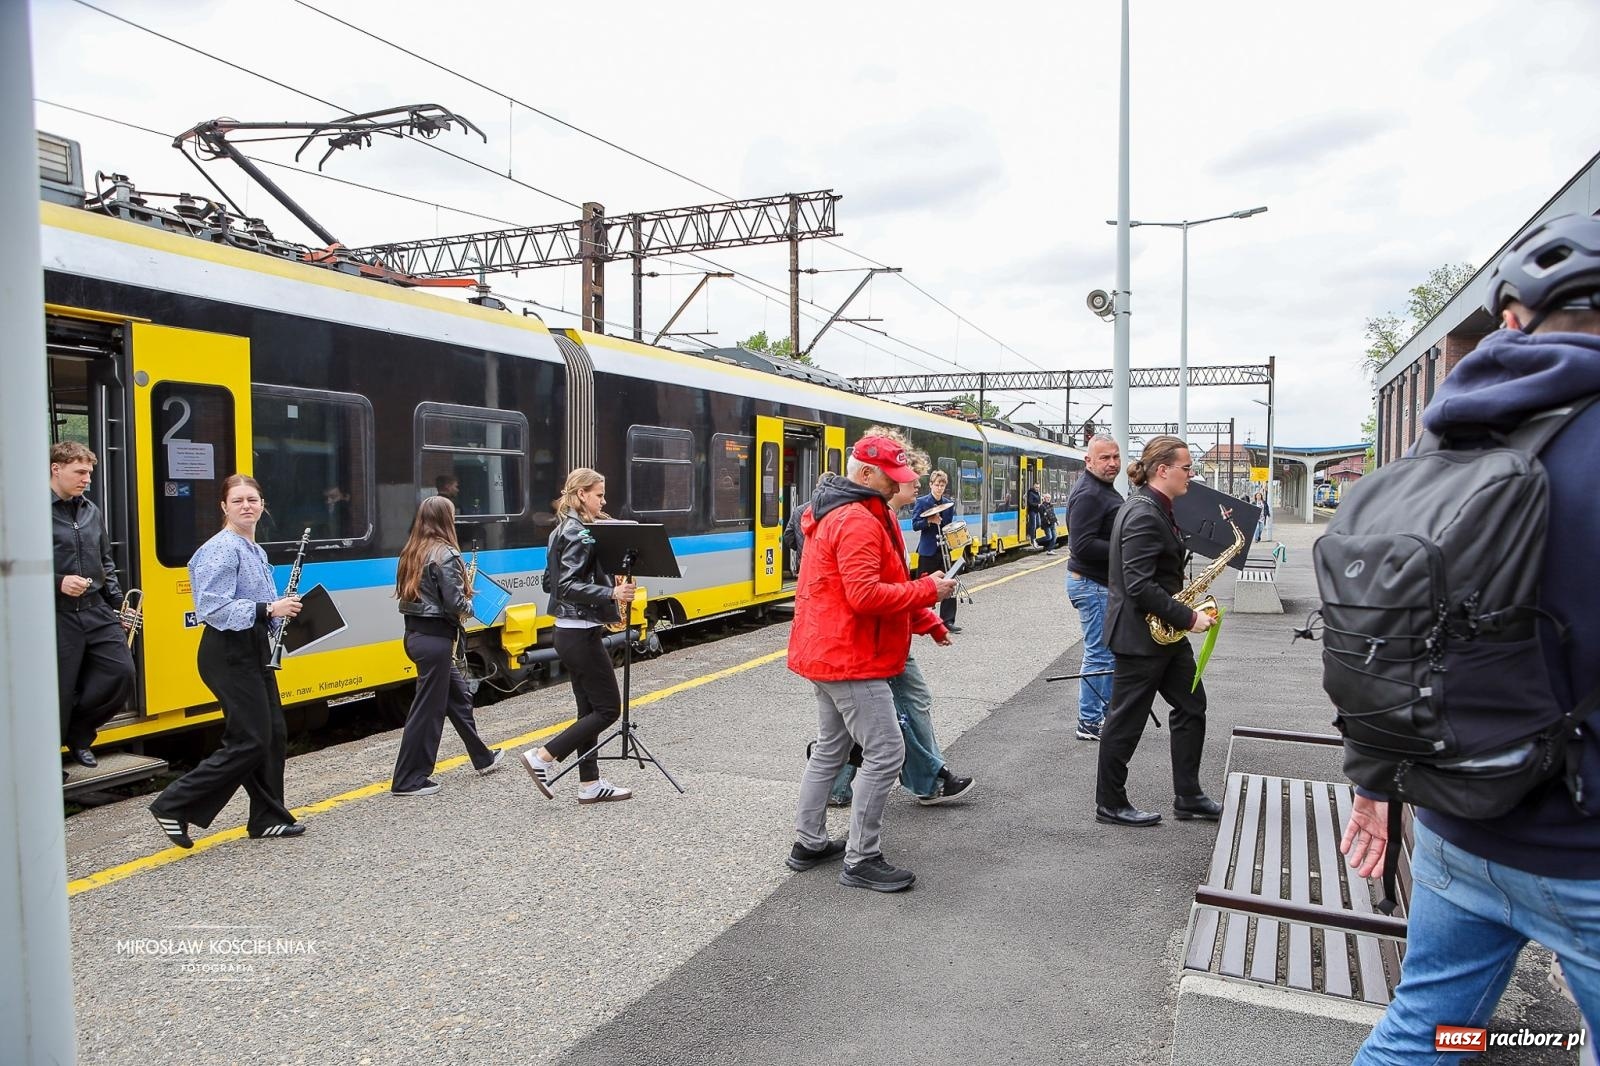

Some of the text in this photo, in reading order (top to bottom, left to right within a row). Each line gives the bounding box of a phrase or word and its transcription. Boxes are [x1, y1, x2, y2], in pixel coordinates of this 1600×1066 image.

[162, 396, 192, 445] 2
[765, 448, 773, 471] 2
[296, 684, 314, 696] naw.
[319, 676, 363, 691] Klimatyzacja
